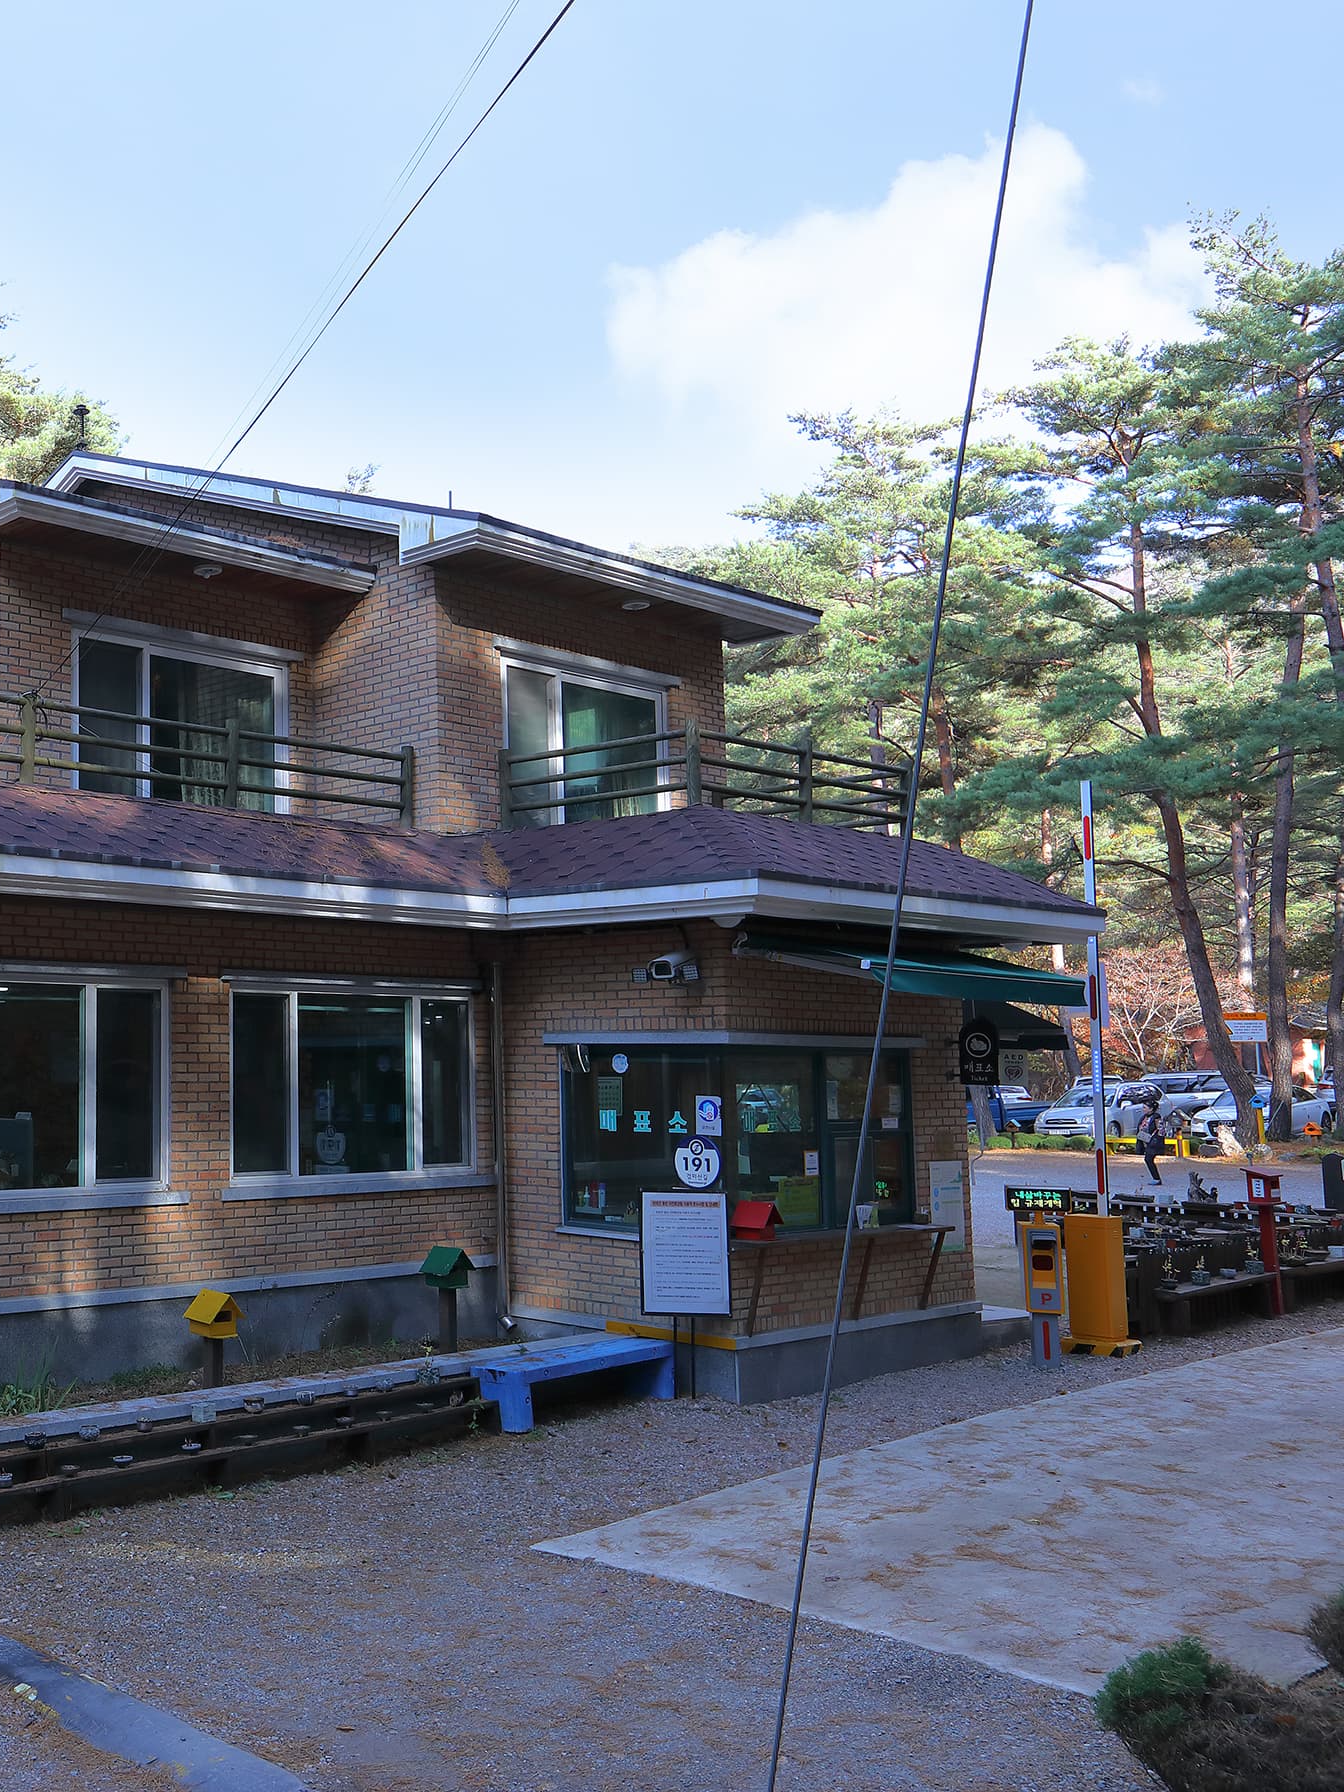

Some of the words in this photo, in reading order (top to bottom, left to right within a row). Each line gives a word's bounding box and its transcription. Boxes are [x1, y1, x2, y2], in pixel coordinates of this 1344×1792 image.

[963, 1060, 994, 1073] 매표소
[599, 1109, 688, 1134] 매표소
[682, 1156, 712, 1173] 191
[1040, 1292, 1053, 1305] P
